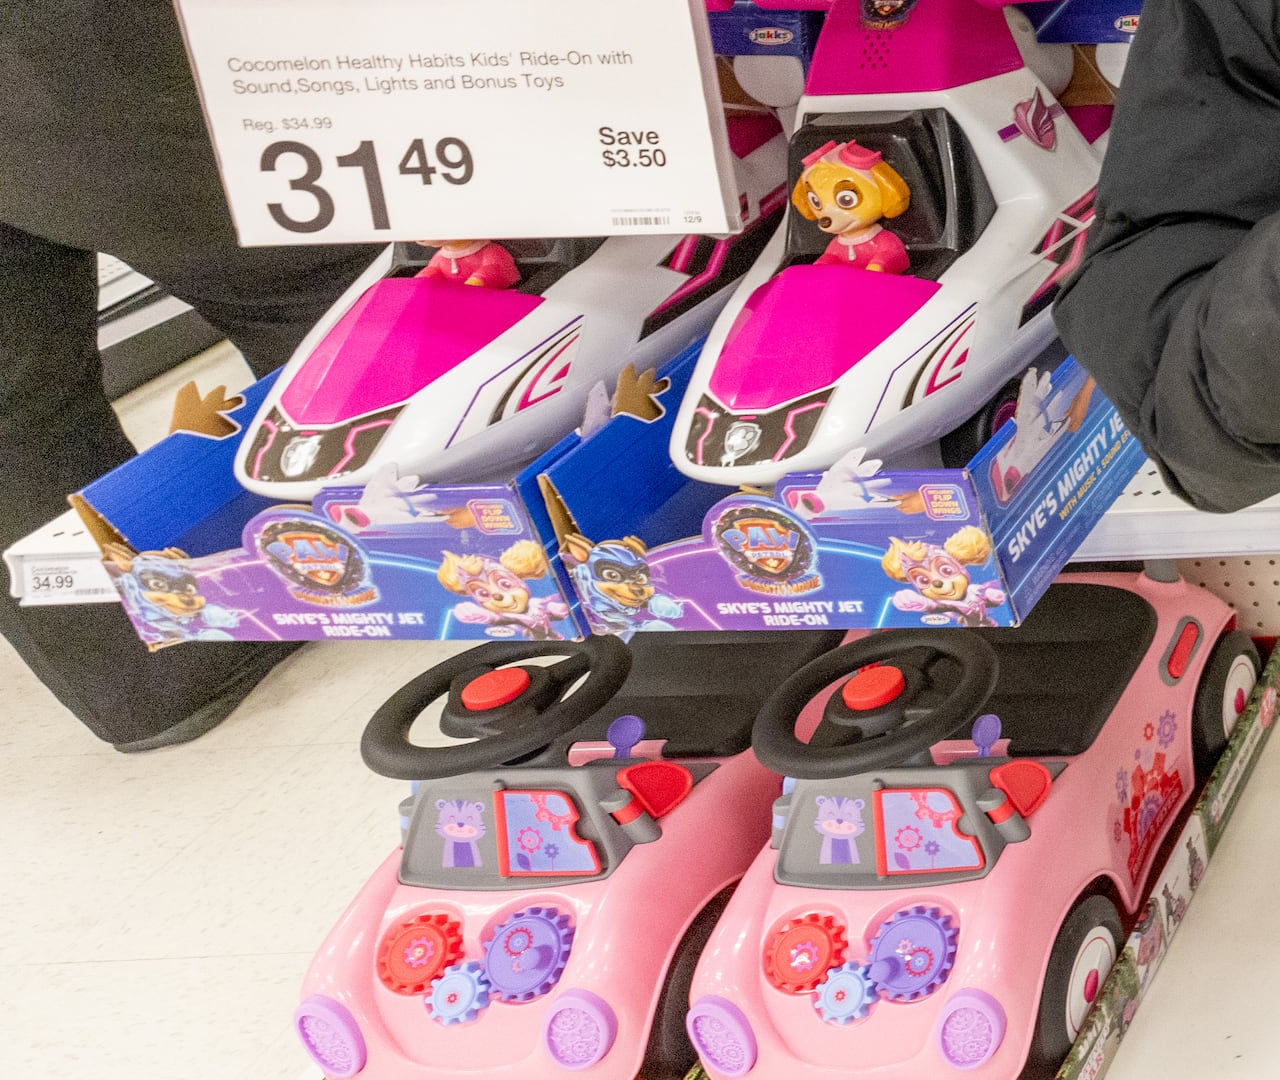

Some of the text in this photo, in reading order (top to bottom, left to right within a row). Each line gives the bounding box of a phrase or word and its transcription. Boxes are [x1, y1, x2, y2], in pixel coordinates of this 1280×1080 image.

[226, 49, 634, 74] Cocomelon Healthy Habits Kids' Ride-On with
[232, 72, 564, 98] Sound,Songs, Lights and Bonus Toys
[242, 116, 333, 134] Reg. $34.99
[599, 125, 661, 147] Save
[602, 148, 667, 168] $3.50
[259, 135, 475, 235] 31 49
[683, 214, 703, 225] 12/9
[1007, 410, 1125, 564] SKYE'S MIGHTY JE
[1059, 496, 1078, 521] WITH
[1077, 473, 1097, 500] MUSIC
[1101, 441, 1123, 469] SOUND
[720, 526, 801, 552] PAW
[268, 538, 352, 567] PAW
[31, 574, 74, 591] 34.99
[275, 610, 424, 626] SKYE'S MIGHTY JET
[716, 600, 864, 615] SKYE'S MIGHTY JET
[322, 624, 391, 637] RIDE-ON
[764, 614, 829, 626] RIDE-ON
